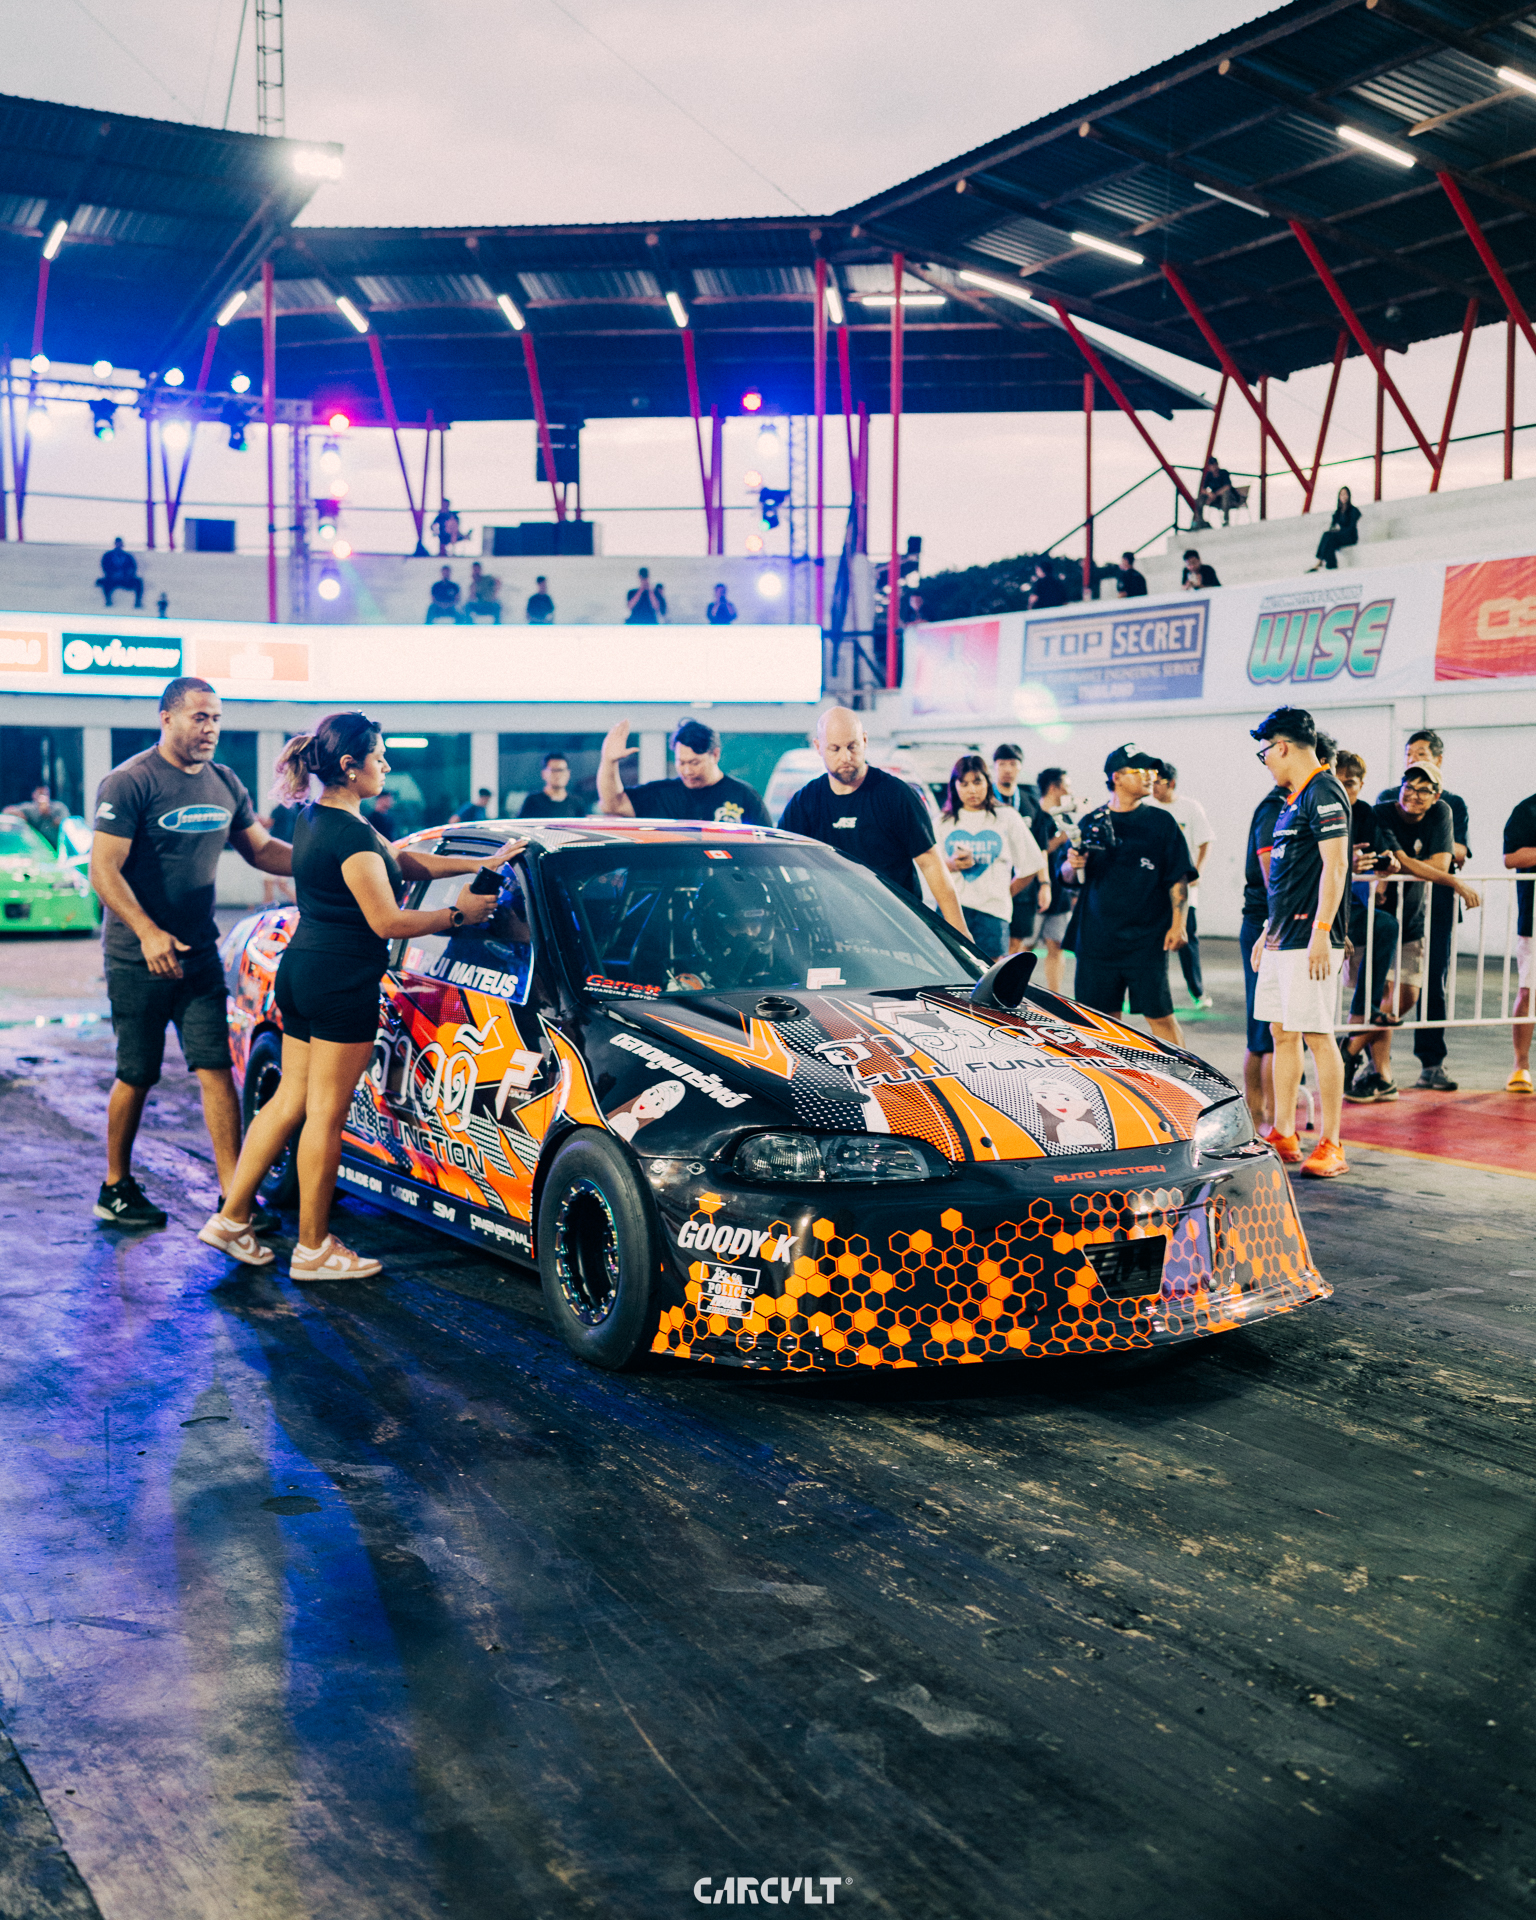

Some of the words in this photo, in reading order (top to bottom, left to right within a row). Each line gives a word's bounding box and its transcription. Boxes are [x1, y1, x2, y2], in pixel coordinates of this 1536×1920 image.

[1040, 632, 1103, 658] TOP
[1113, 618, 1197, 656] SECRET
[1247, 598, 1395, 686] WISE
[447, 960, 519, 998] MATEUS
[583, 985, 627, 996] ADVANCING
[628, 989, 659, 1001] MOTION
[586, 974, 662, 997] Garrett
[857, 1064, 959, 1089] FULL
[966, 1056, 1154, 1074] FUNCTION
[375, 1111, 488, 1178] FUNCTION
[1053, 1171, 1097, 1184] AUTO
[1098, 1164, 1167, 1178] FACTORY
[677, 1220, 772, 1258] GOODY
[770, 1234, 800, 1264] K
